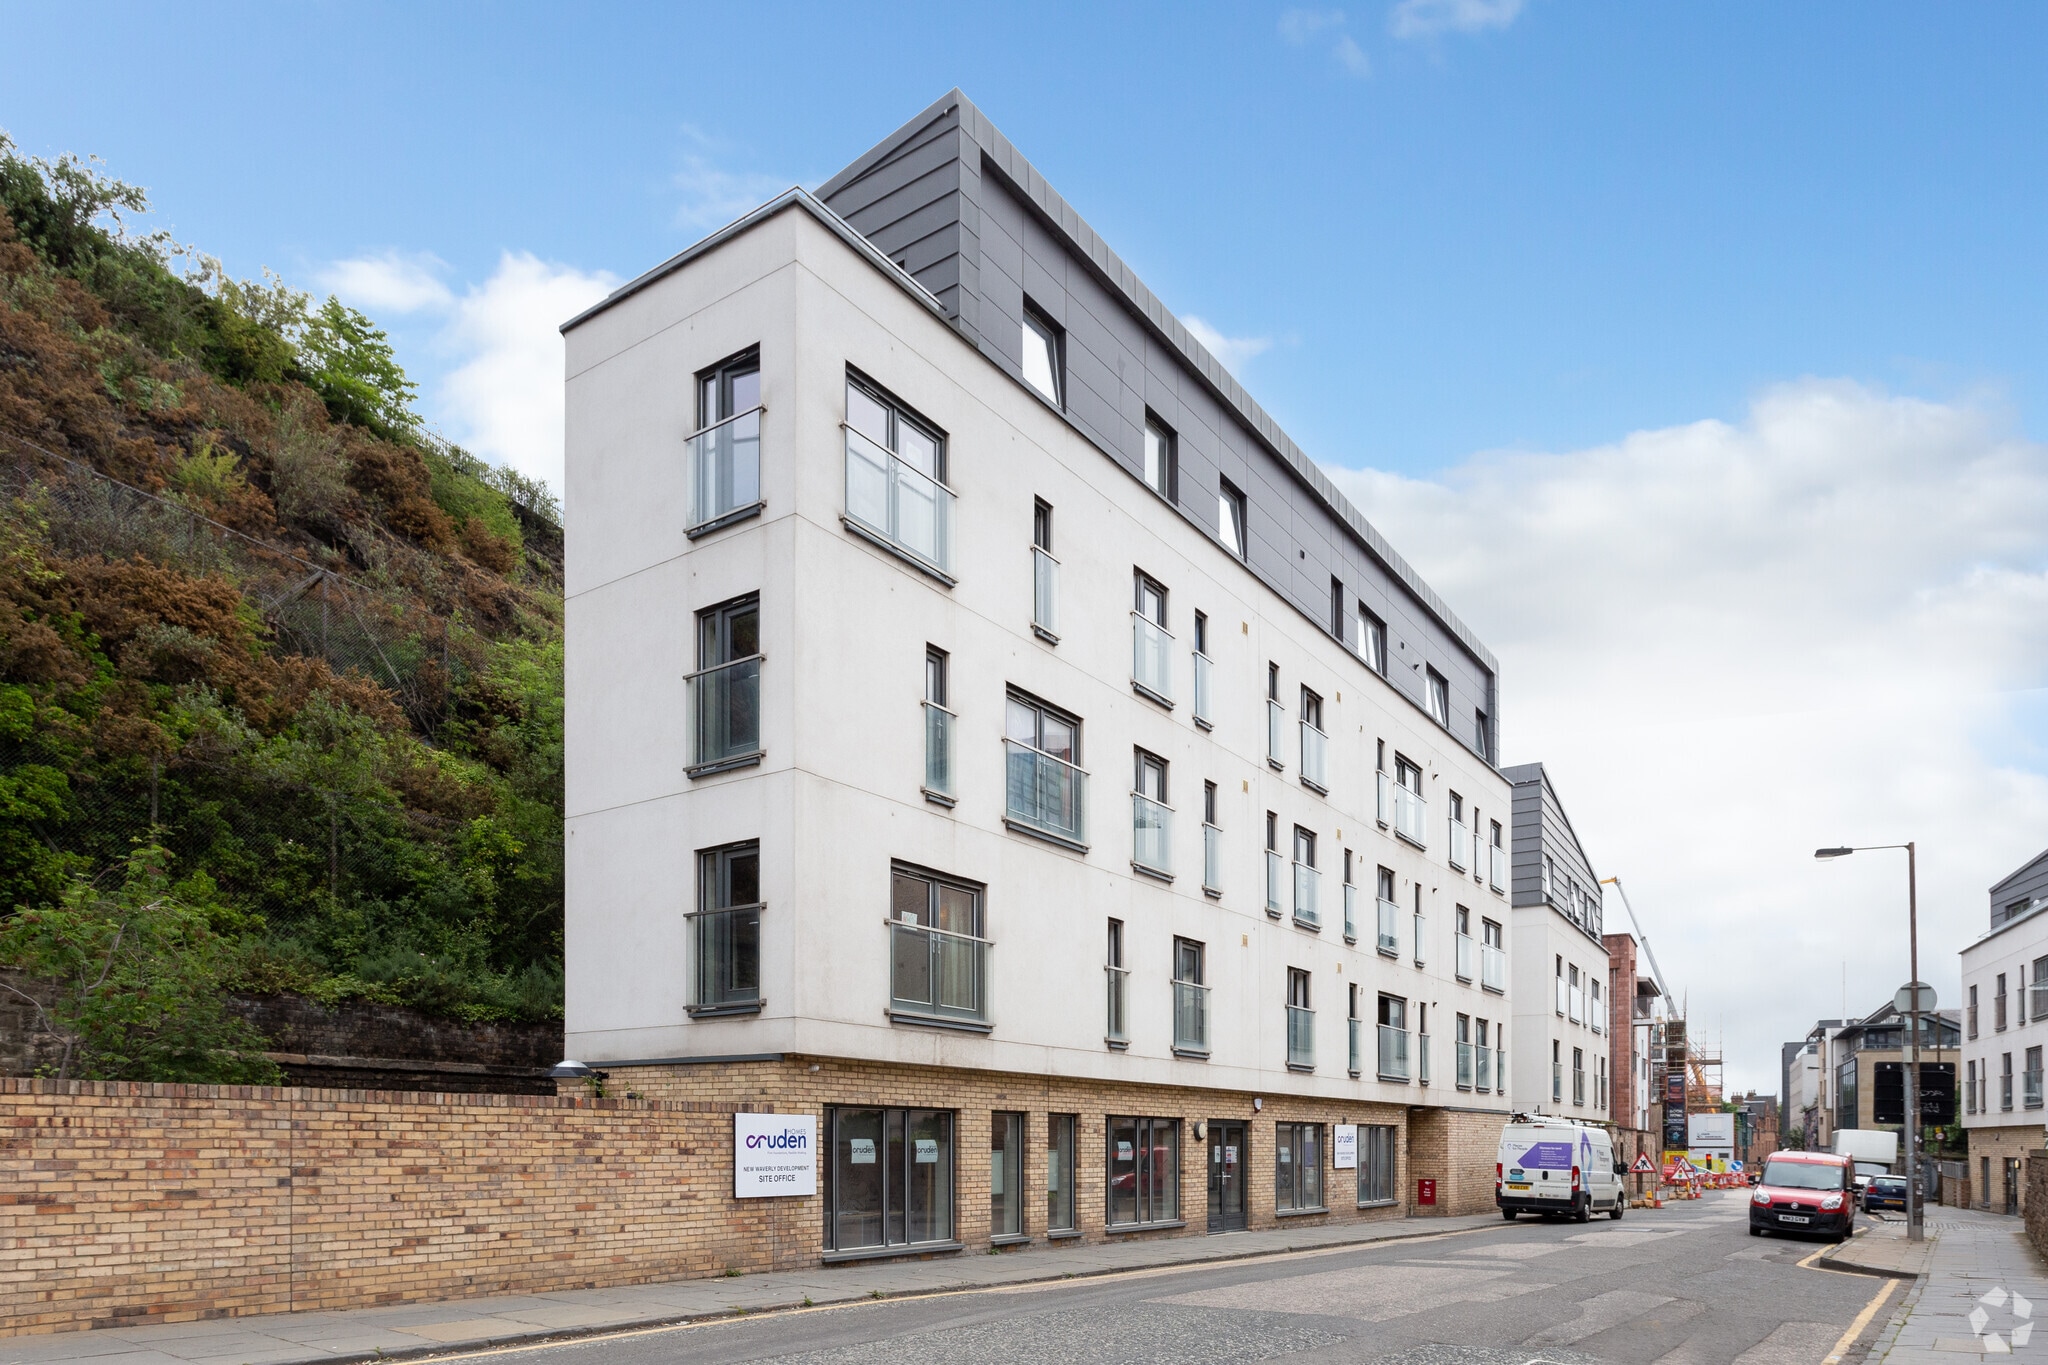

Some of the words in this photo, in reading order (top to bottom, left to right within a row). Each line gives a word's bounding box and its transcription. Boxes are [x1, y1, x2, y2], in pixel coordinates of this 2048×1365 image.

[746, 1128, 807, 1149] cruden
[852, 1145, 875, 1154] cruden
[917, 1145, 937, 1154] cruden
[773, 1174, 796, 1182] OFFICE
